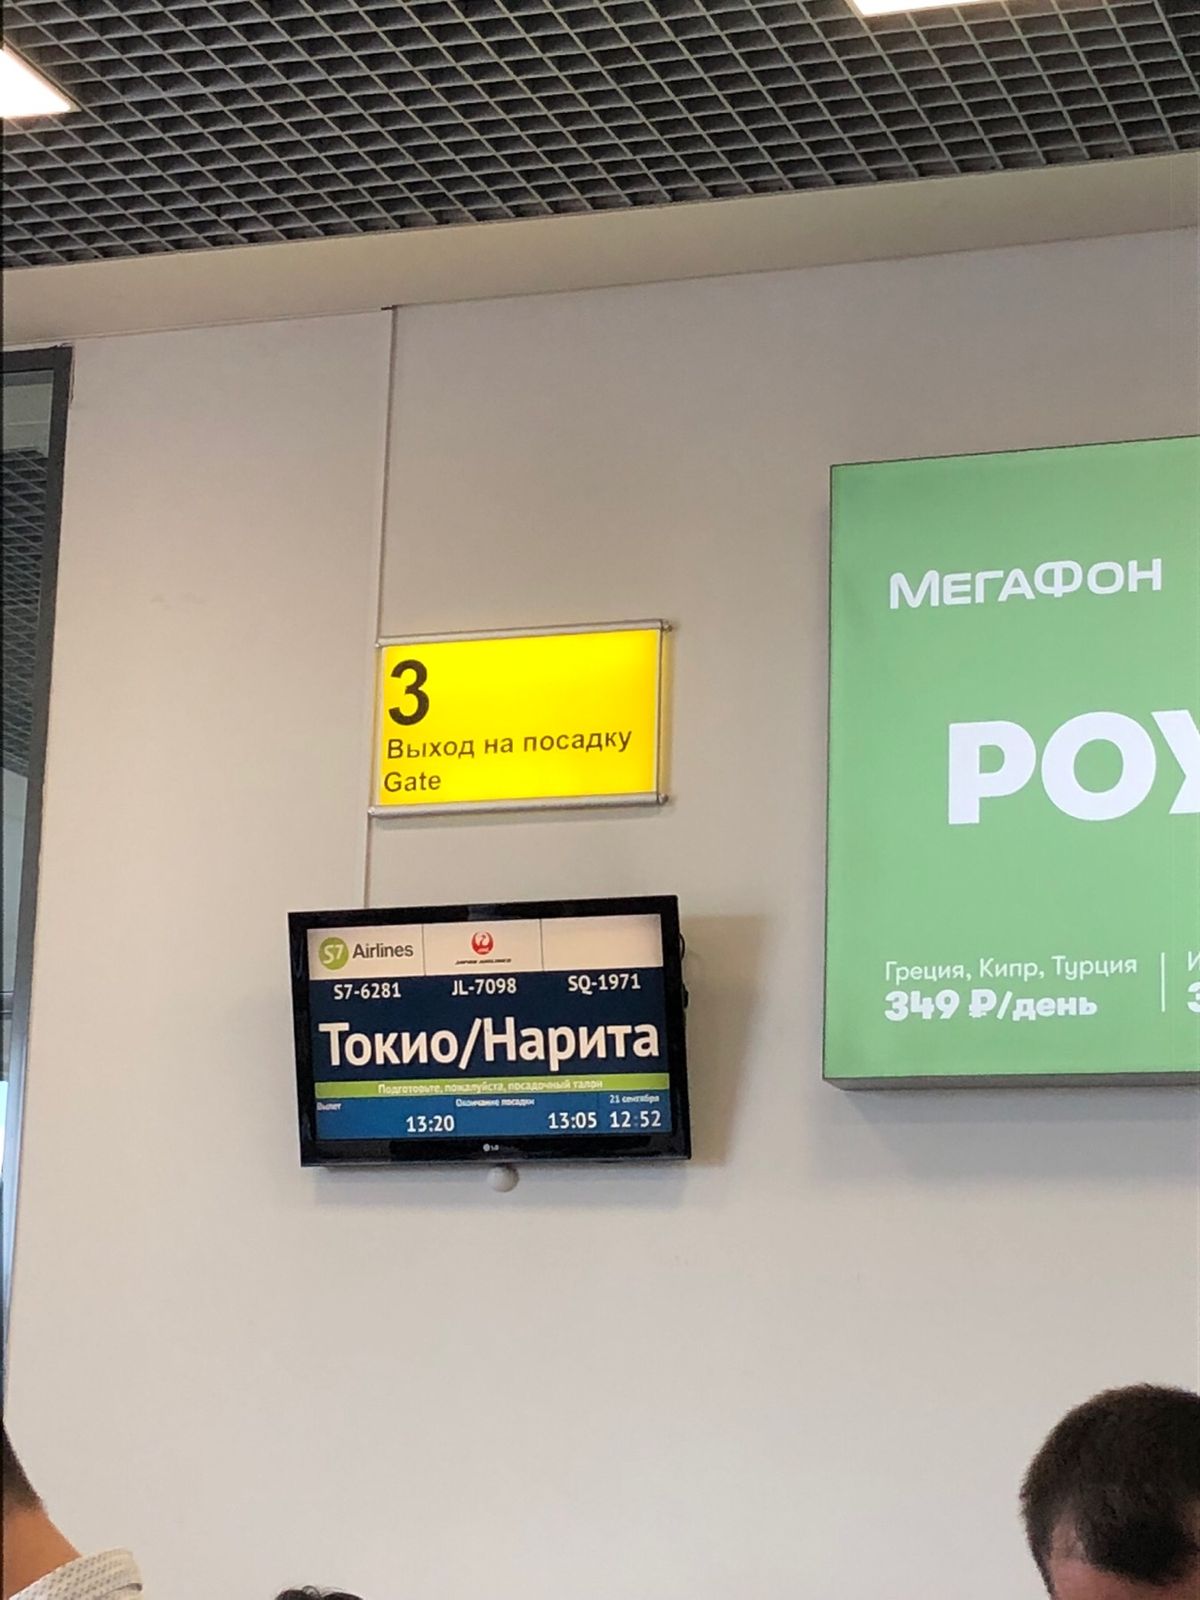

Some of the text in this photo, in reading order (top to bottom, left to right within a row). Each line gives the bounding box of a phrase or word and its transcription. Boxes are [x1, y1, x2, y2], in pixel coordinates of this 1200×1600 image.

[889, 557, 1163, 610] МЕГАФОН
[388, 659, 430, 726] 3
[387, 730, 633, 759] Выход на посадку
[383, 771, 442, 793] Gate
[322, 943, 414, 965] S7 Airlines
[885, 955, 1138, 985] Греция, Кипр, Турция
[333, 982, 402, 1000] S7-6281
[451, 978, 517, 996] JL-7098
[568, 973, 641, 995] SQ-1971
[884, 989, 961, 1022] 349
[318, 1016, 660, 1071] Токио/Нарита
[609, 1095, 620, 1104] 21
[406, 1115, 455, 1133] 13:20
[548, 1112, 598, 1129] 13:05
[609, 1110, 662, 1128] 12:52
